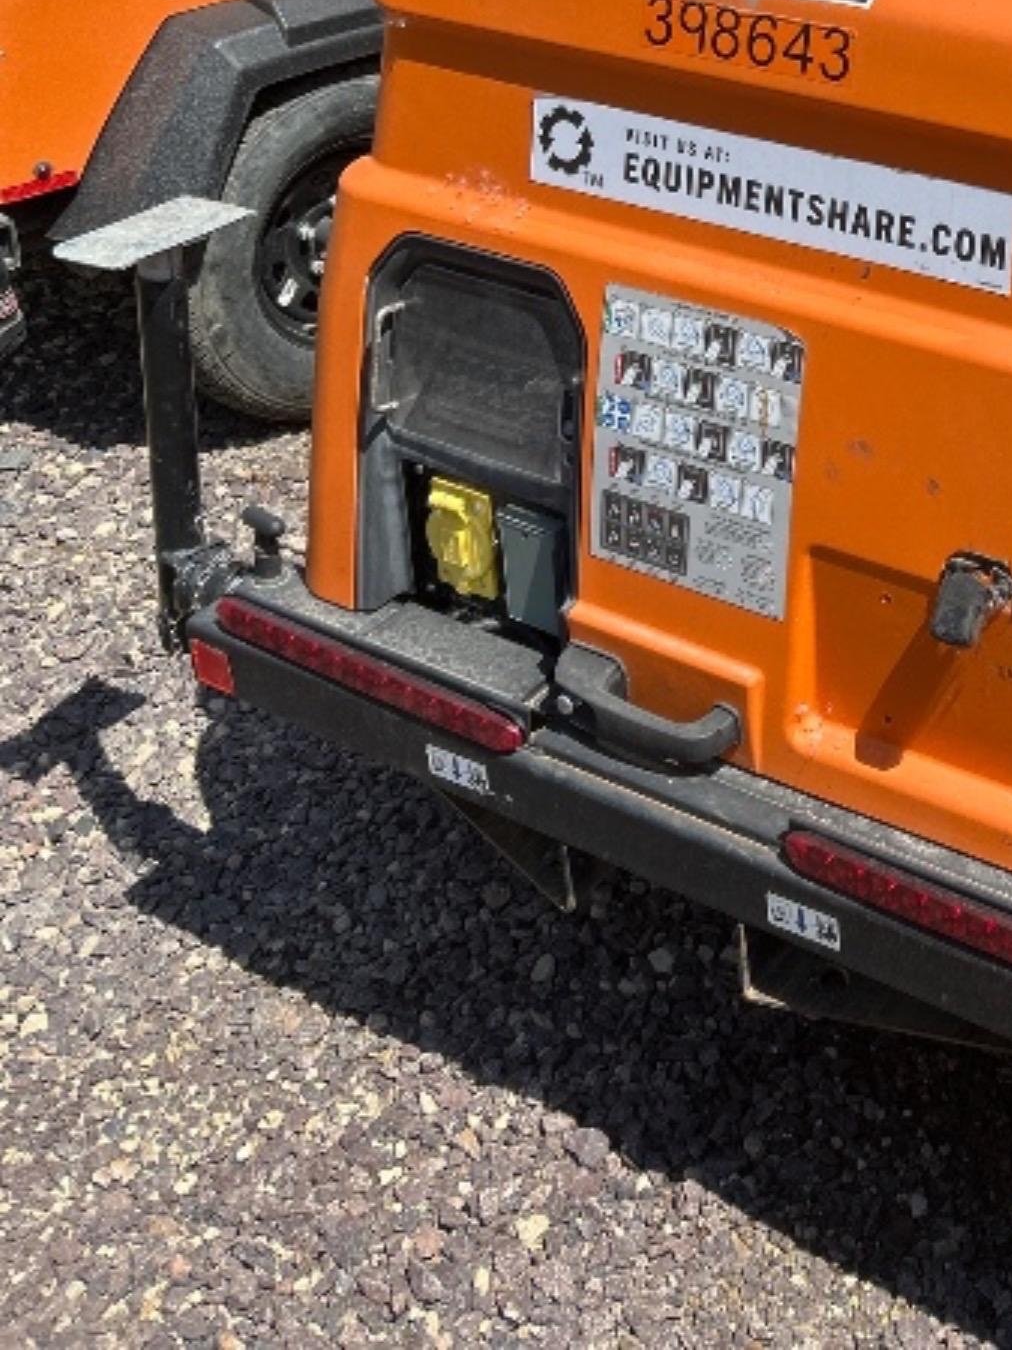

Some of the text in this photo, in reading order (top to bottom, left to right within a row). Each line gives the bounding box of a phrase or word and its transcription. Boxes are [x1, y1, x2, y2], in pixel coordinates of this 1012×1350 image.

[625, 128, 731, 163] VISIT US AT:
[623, 152, 1006, 271] EQUIPMENTSHARE.COM
